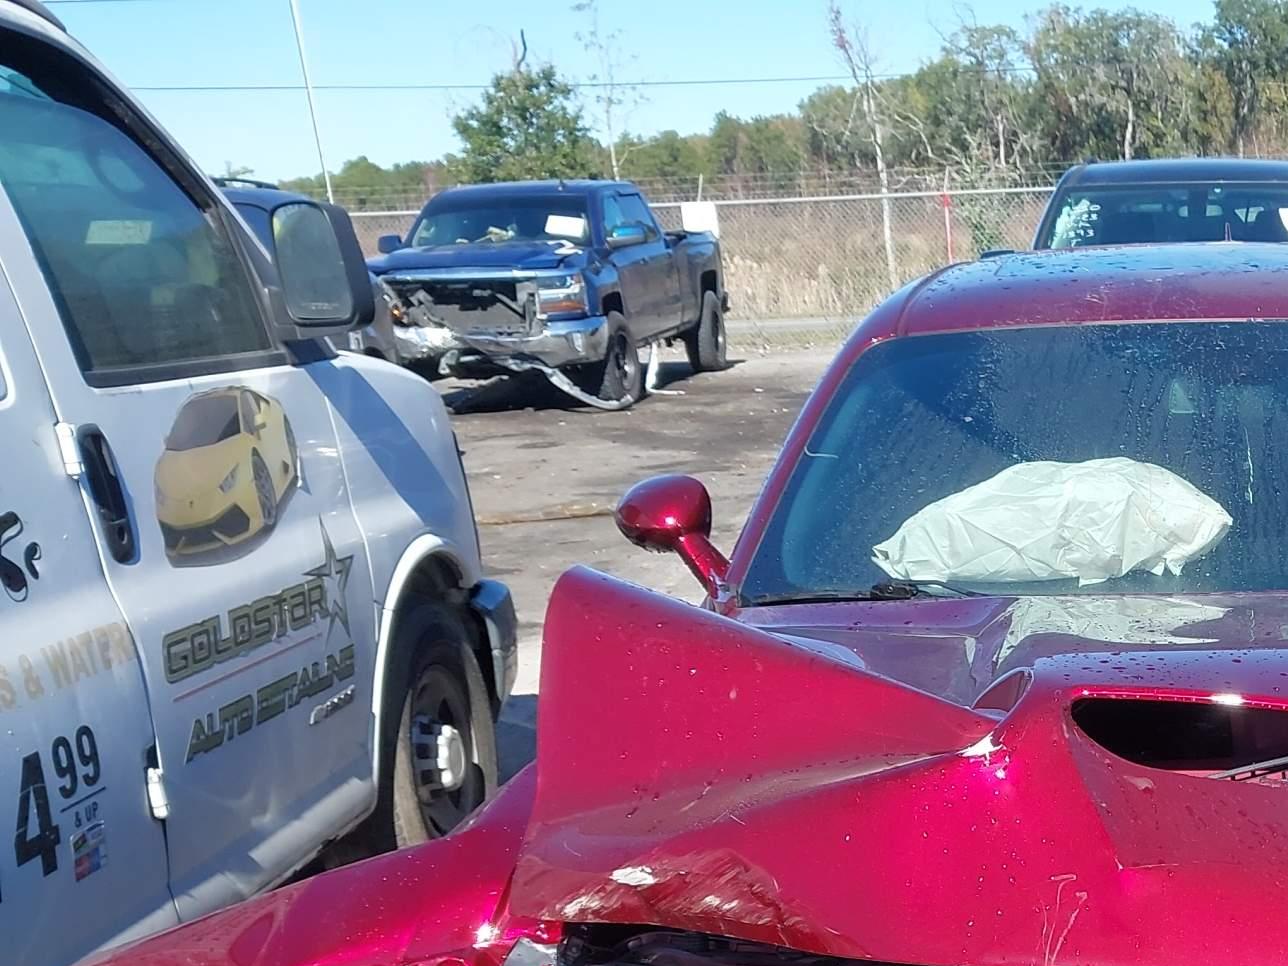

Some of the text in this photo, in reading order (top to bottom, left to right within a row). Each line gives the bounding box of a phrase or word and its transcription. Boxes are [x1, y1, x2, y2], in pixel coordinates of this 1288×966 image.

[185, 693, 255, 766] AUTO
[256, 643, 355, 726] DETAILING
[74, 801, 99, 828] & UP
